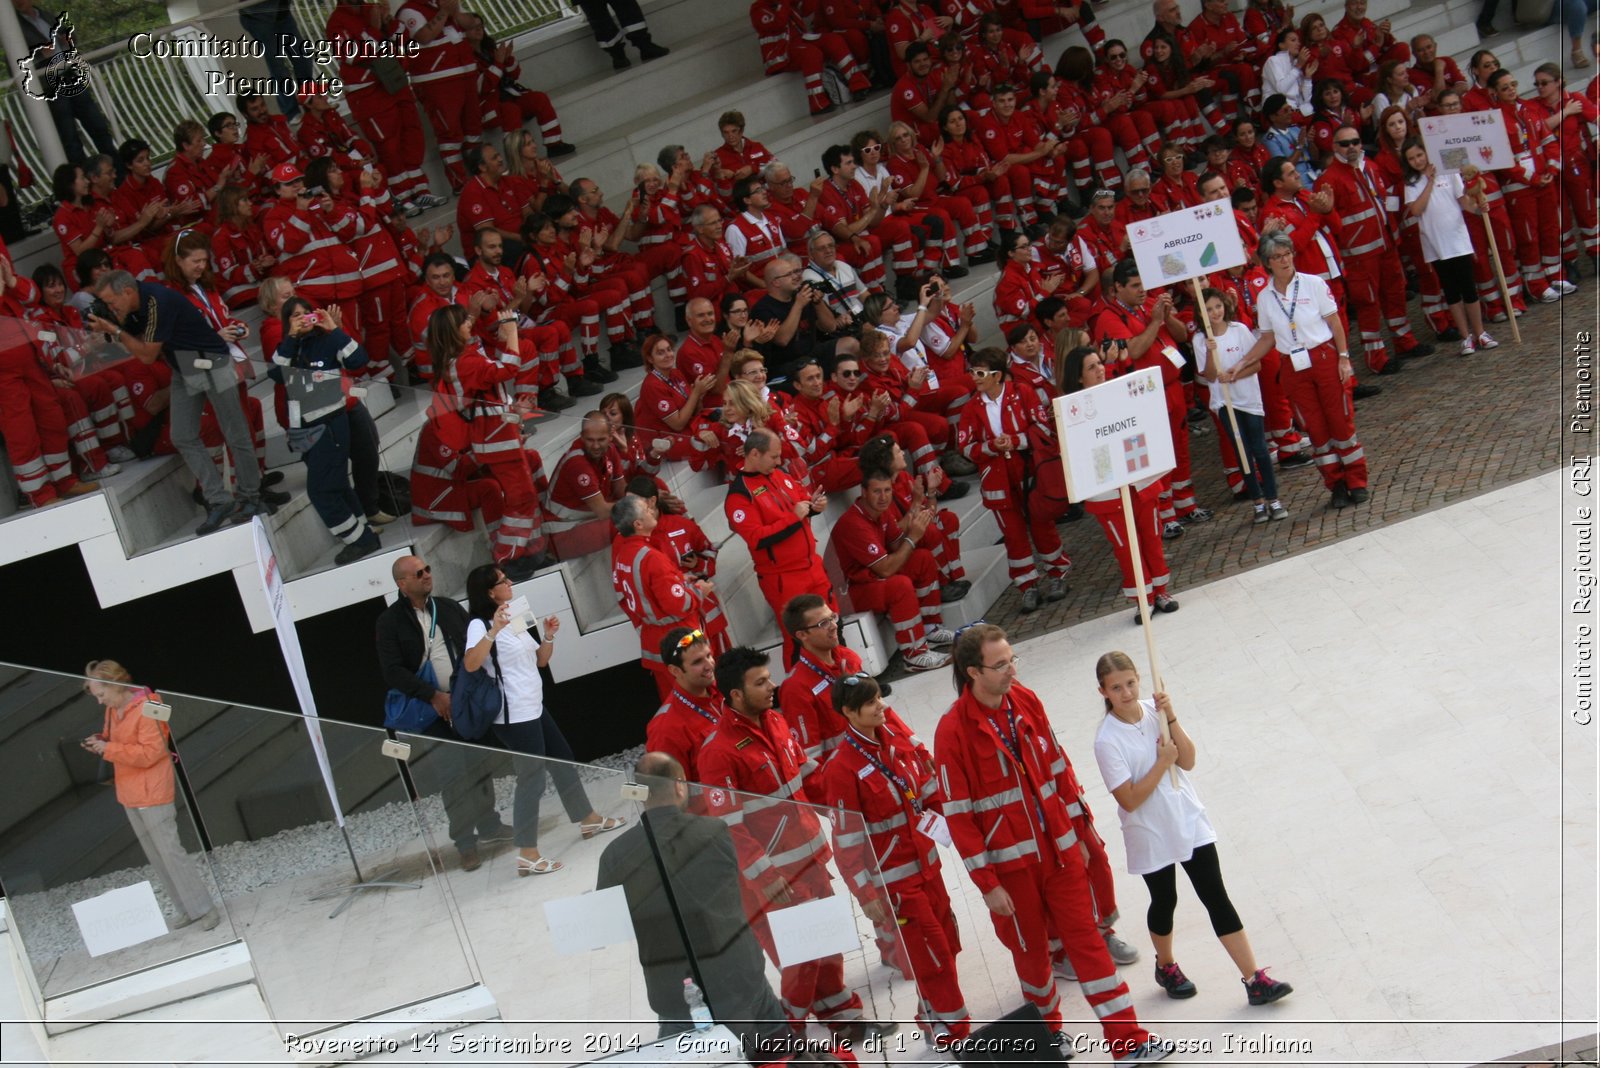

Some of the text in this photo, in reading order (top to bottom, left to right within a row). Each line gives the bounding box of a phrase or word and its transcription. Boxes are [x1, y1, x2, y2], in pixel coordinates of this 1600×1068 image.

[1445, 135, 1482, 145] ALTO ADIGE
[1164, 233, 1203, 249] ABRUZZO
[1095, 416, 1137, 438] PIEMONTE
